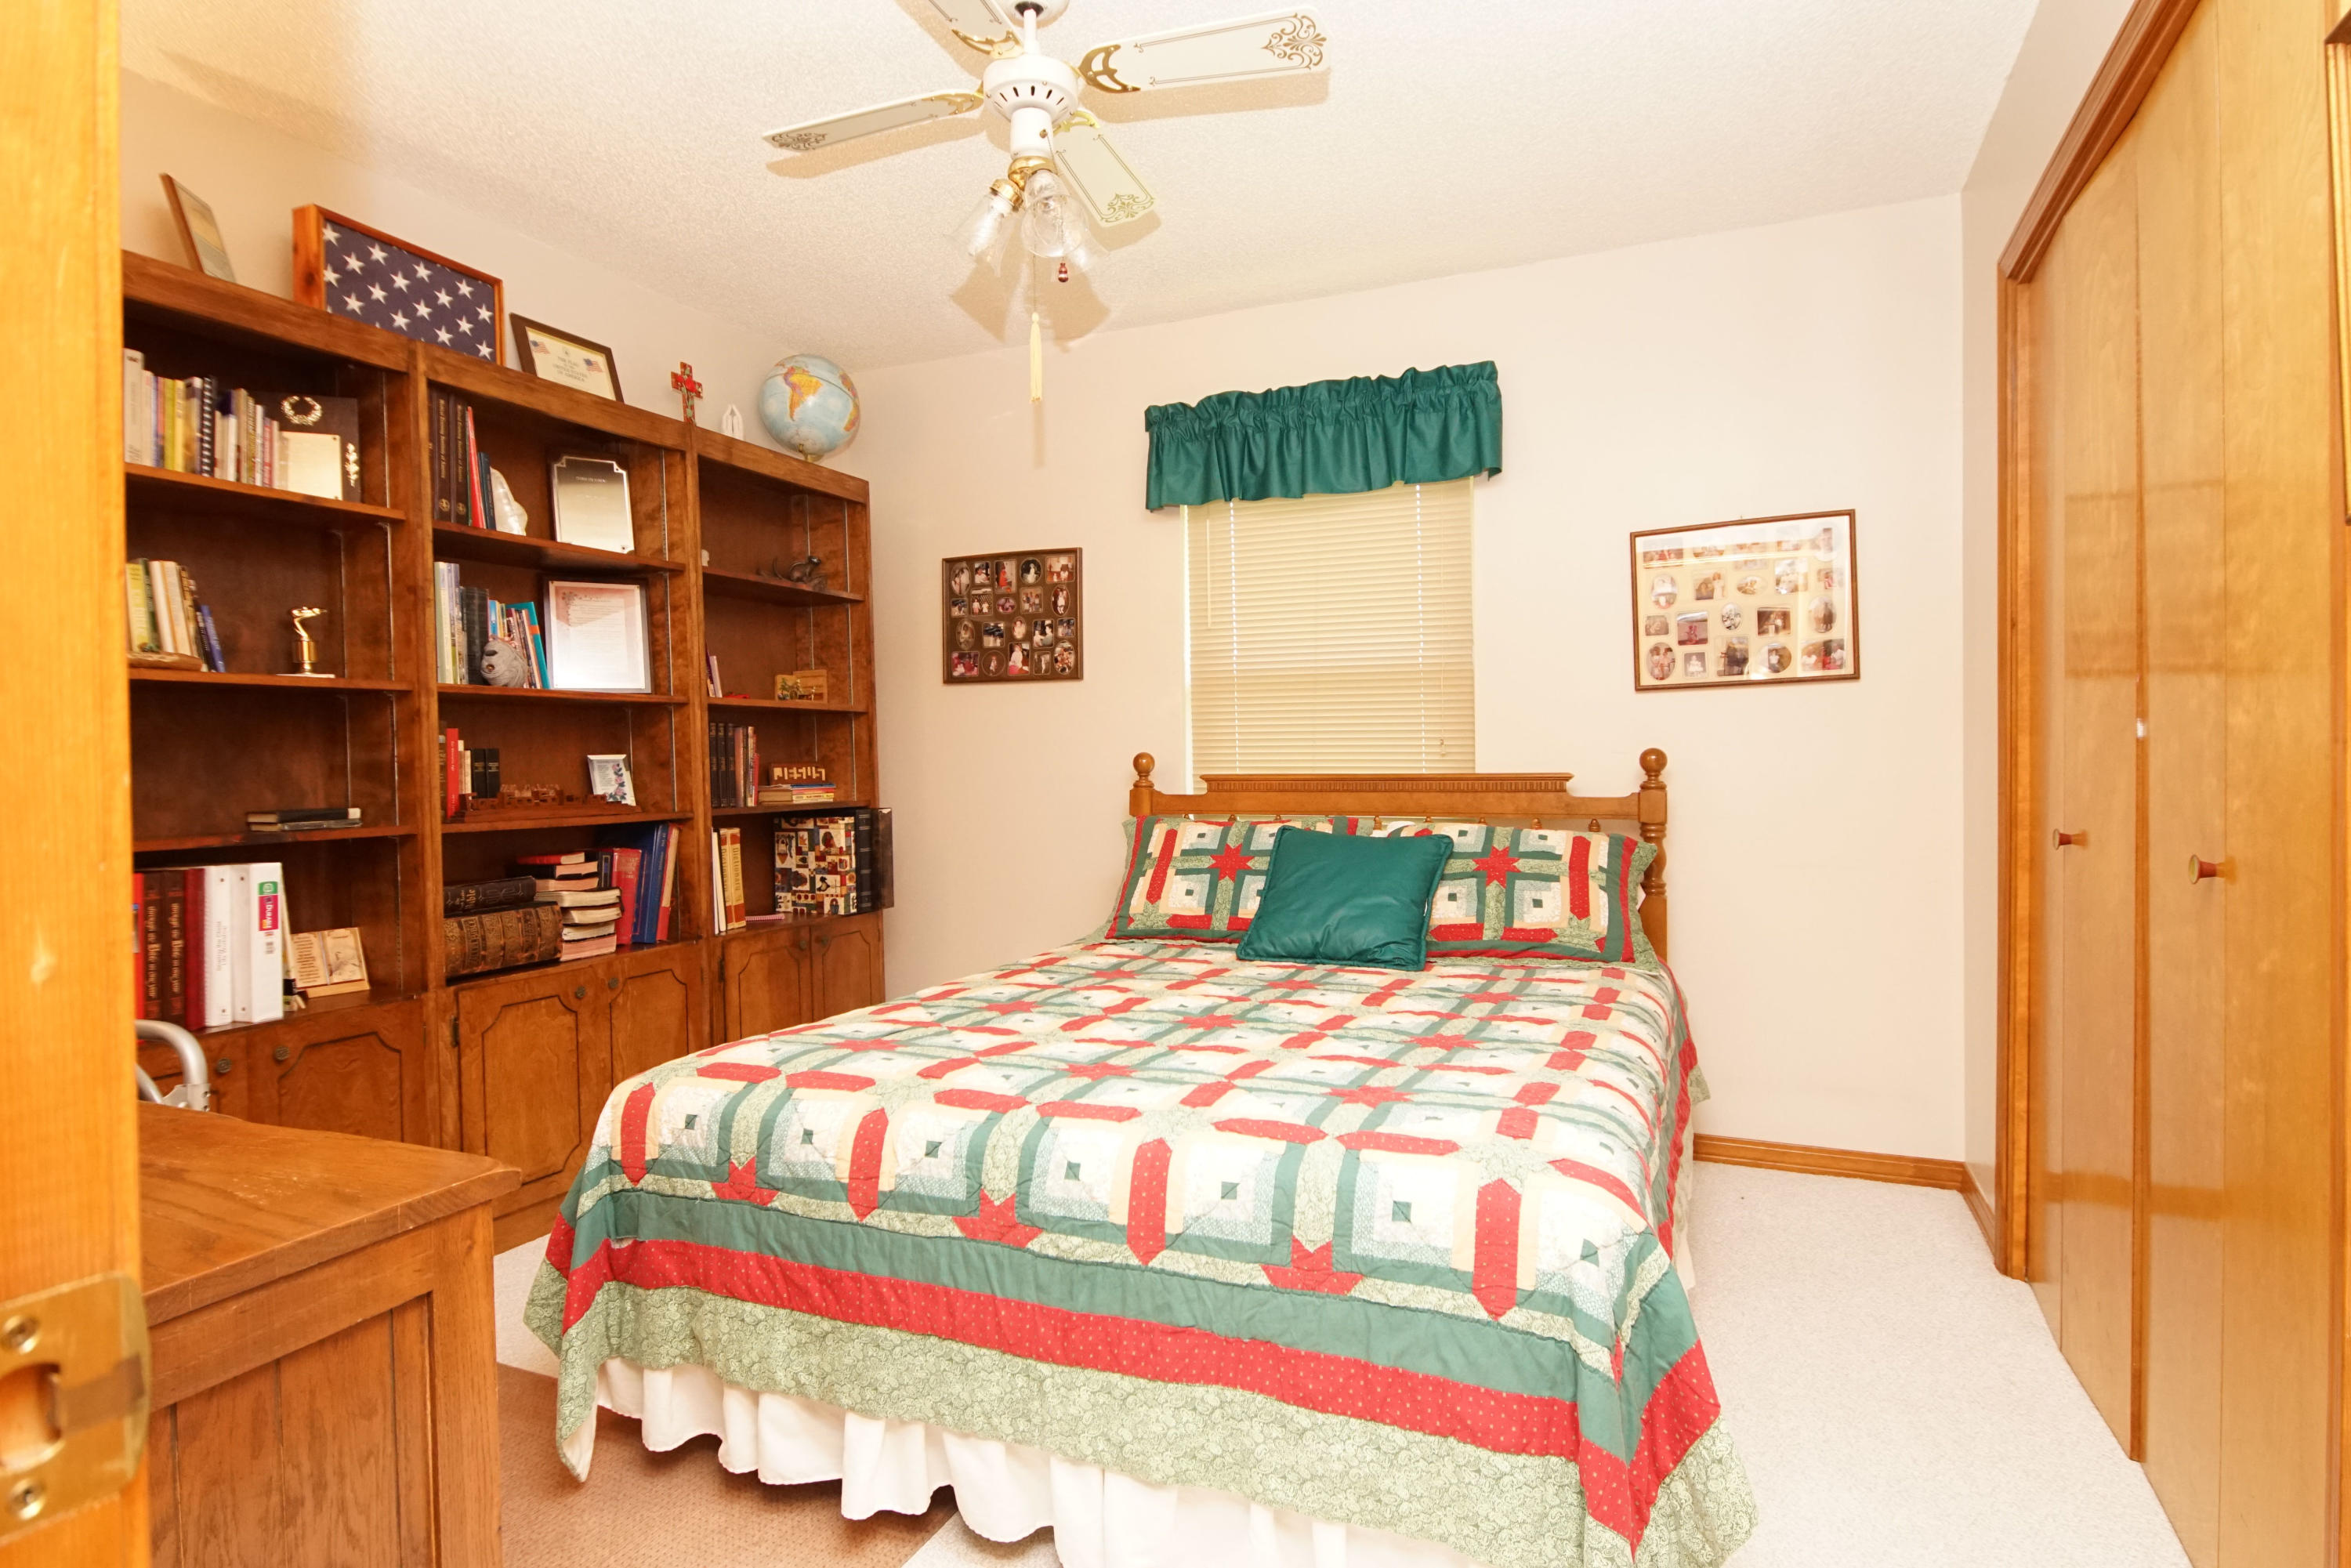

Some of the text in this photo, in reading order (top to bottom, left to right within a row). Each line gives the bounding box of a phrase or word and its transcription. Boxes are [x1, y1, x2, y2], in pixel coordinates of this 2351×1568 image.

[732, 847, 741, 891] Dictionary
[148, 943, 161, 962] Bible
[172, 940, 184, 958] Bible
